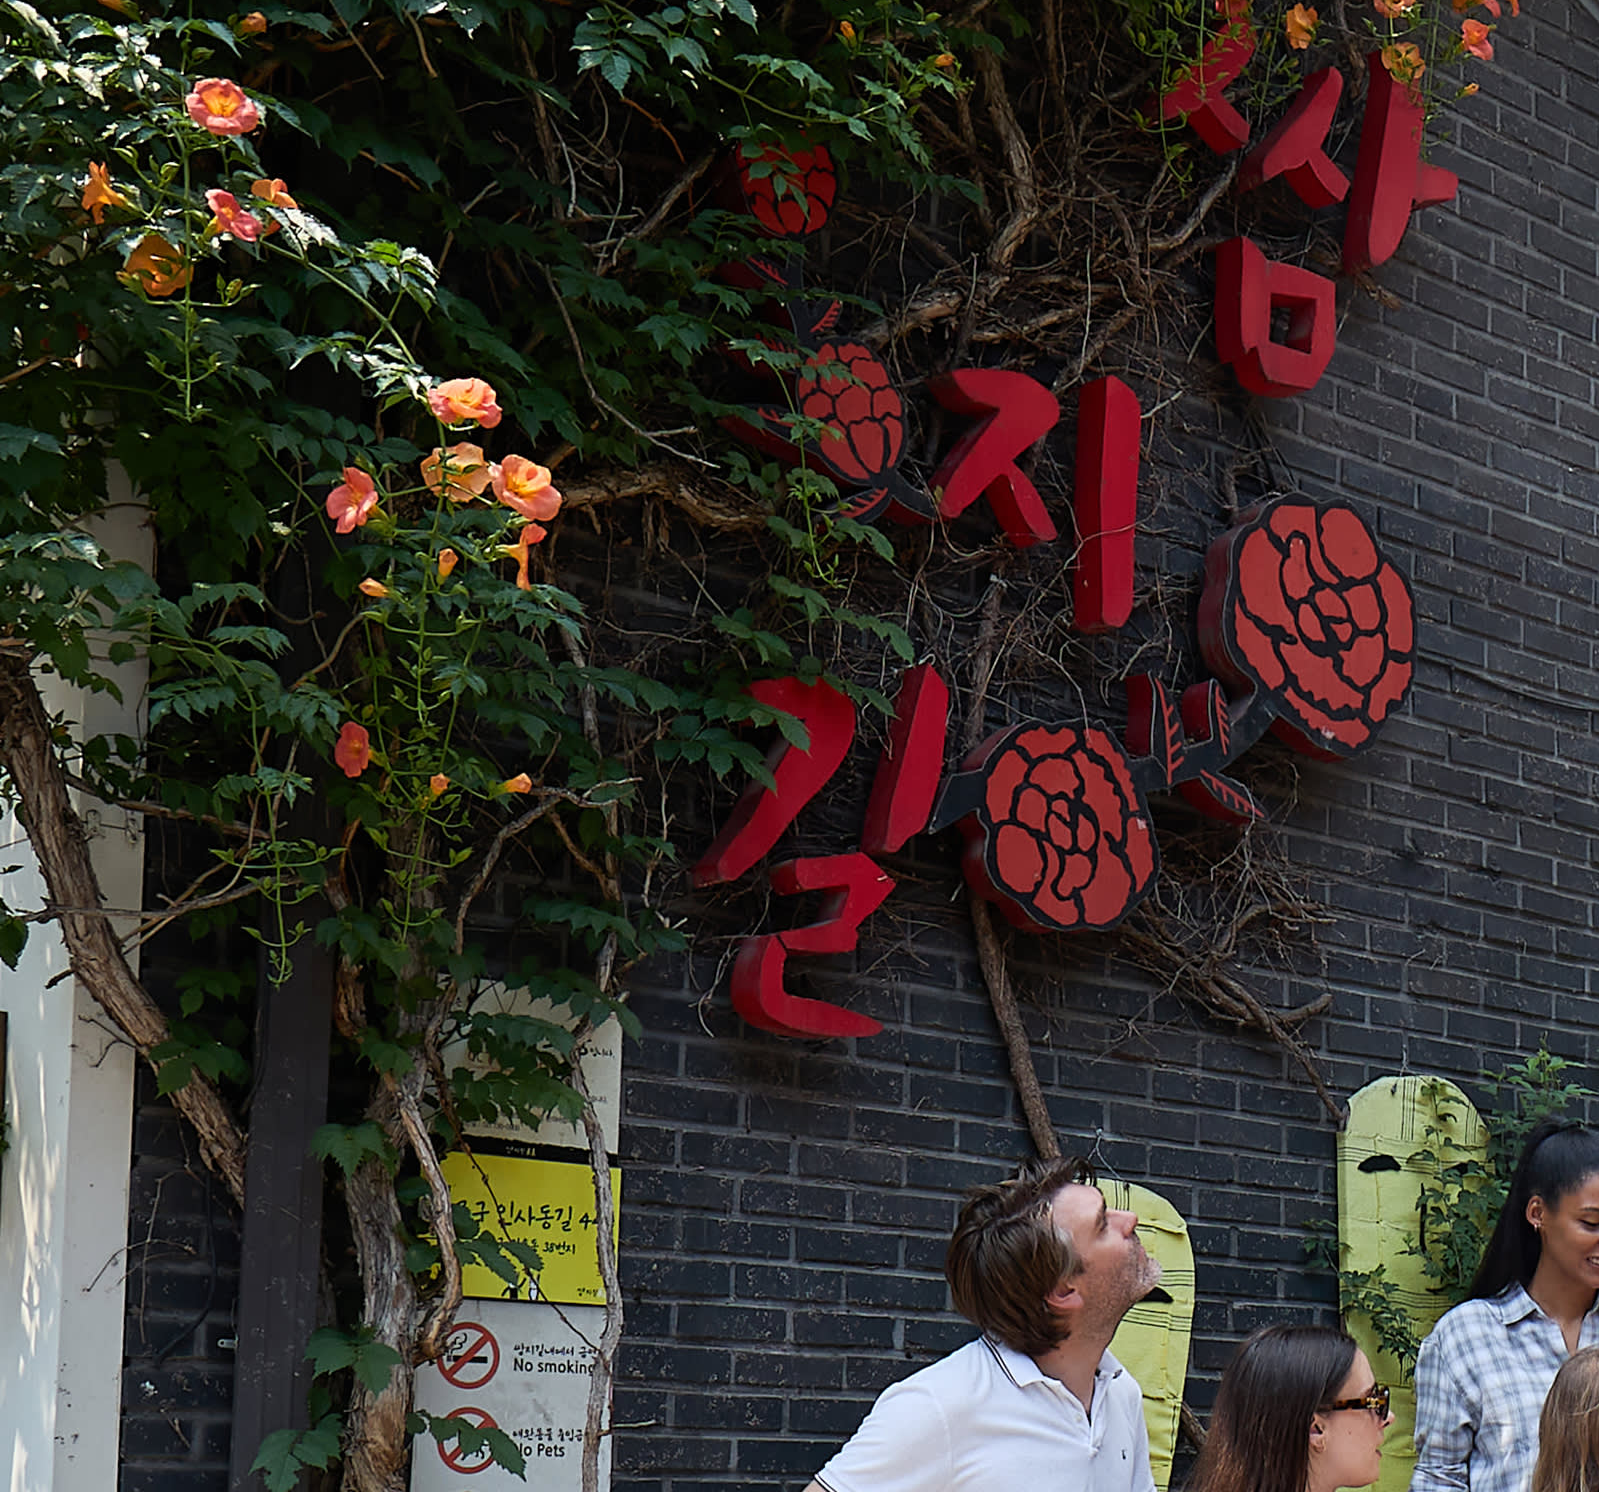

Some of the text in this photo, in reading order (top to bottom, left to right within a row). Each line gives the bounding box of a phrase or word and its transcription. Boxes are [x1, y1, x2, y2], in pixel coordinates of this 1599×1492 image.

[513, 1357, 533, 1372] No
[557, 1428, 583, 1442] 출입금
[537, 1443, 566, 1458] Pets
